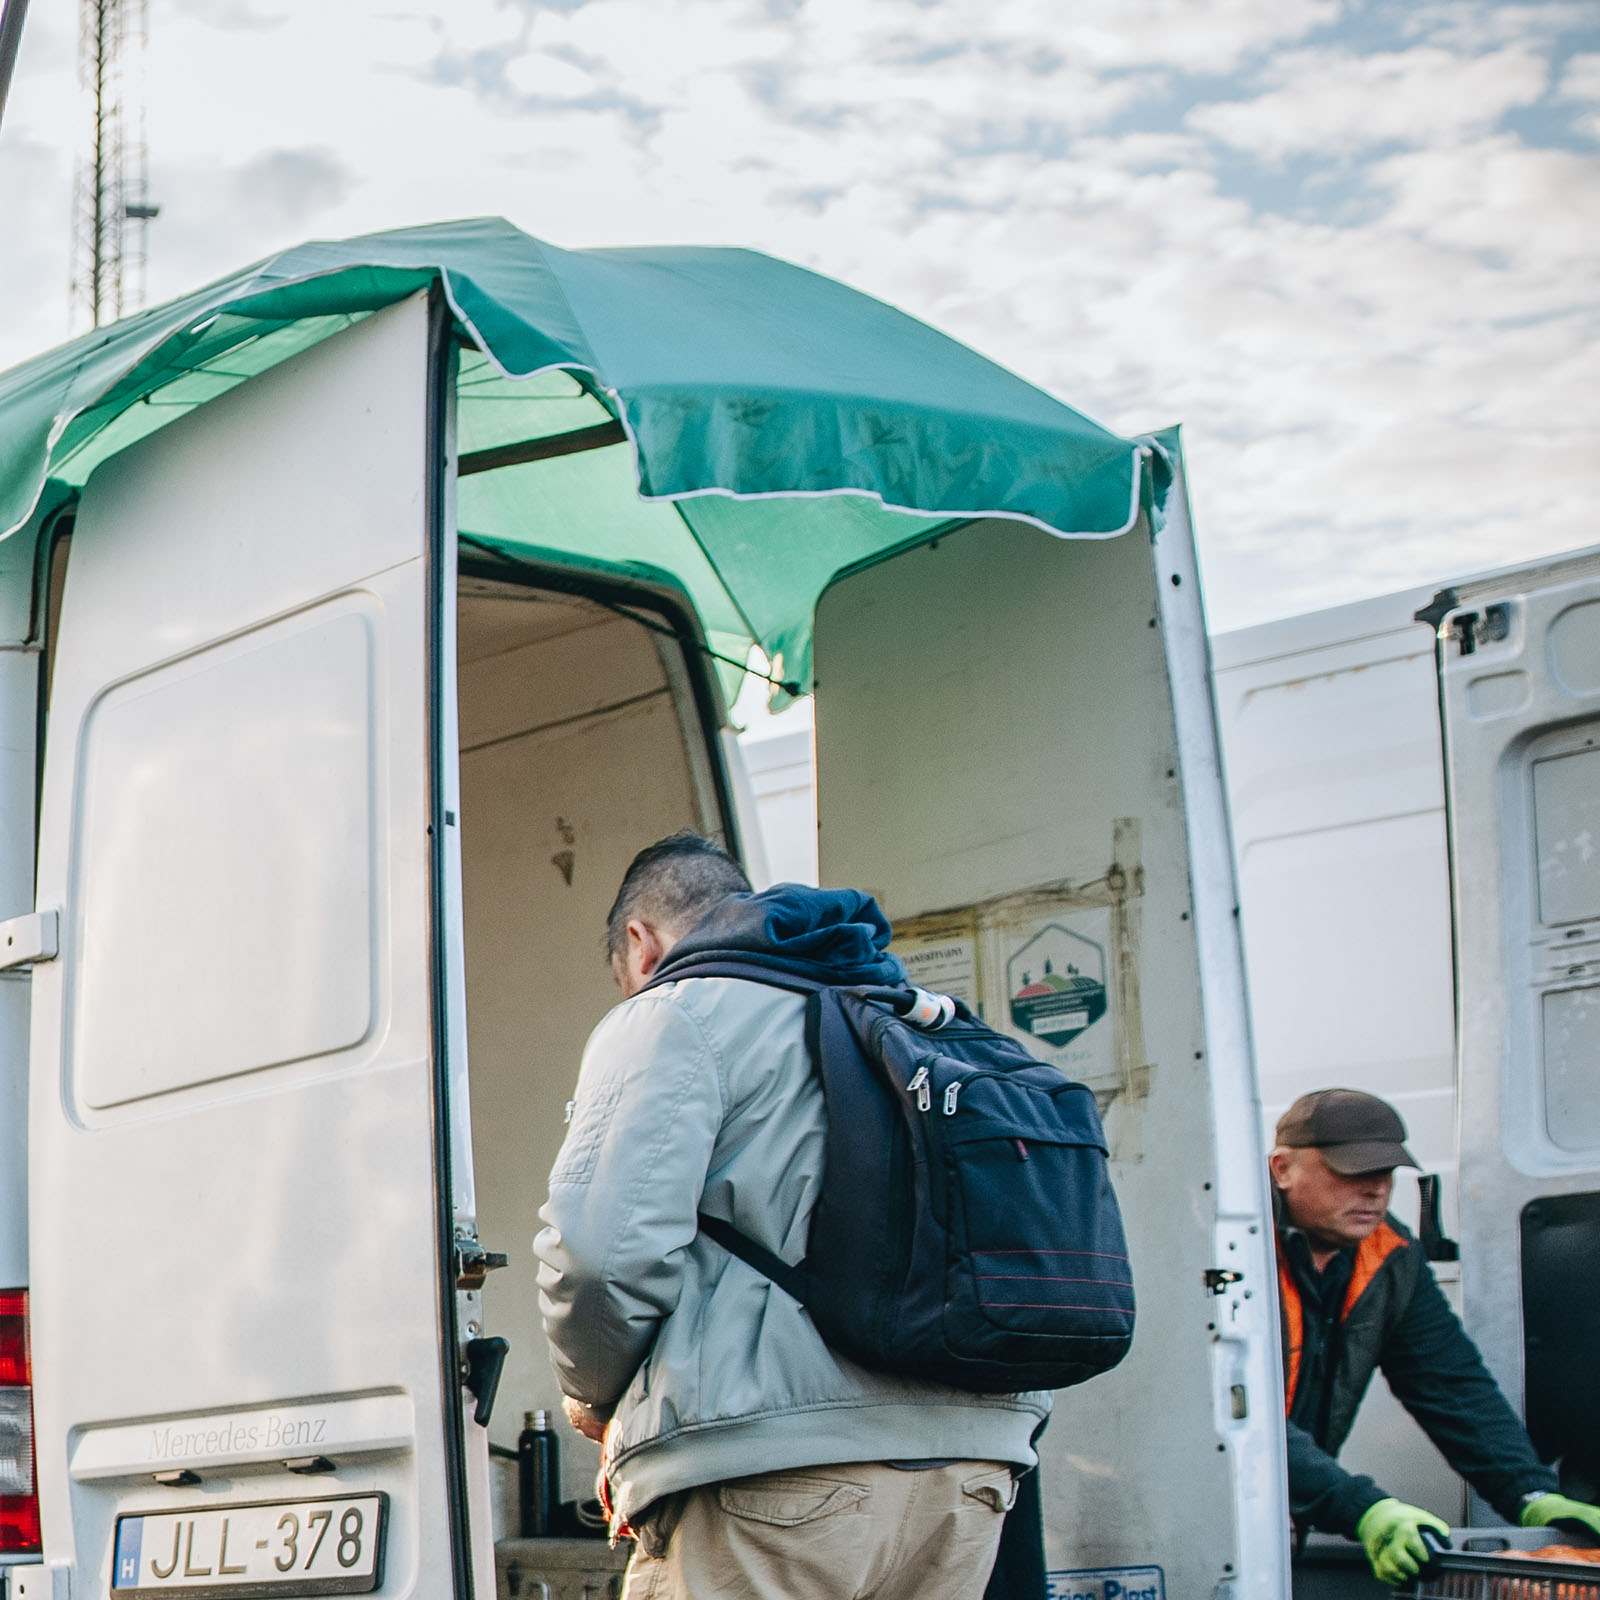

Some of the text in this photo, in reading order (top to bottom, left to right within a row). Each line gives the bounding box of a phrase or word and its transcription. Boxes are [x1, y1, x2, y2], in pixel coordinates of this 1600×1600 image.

[147, 1415, 327, 1460] Mercedes-Benz
[151, 1507, 363, 1579] JLL-378
[122, 1559, 134, 1579] H
